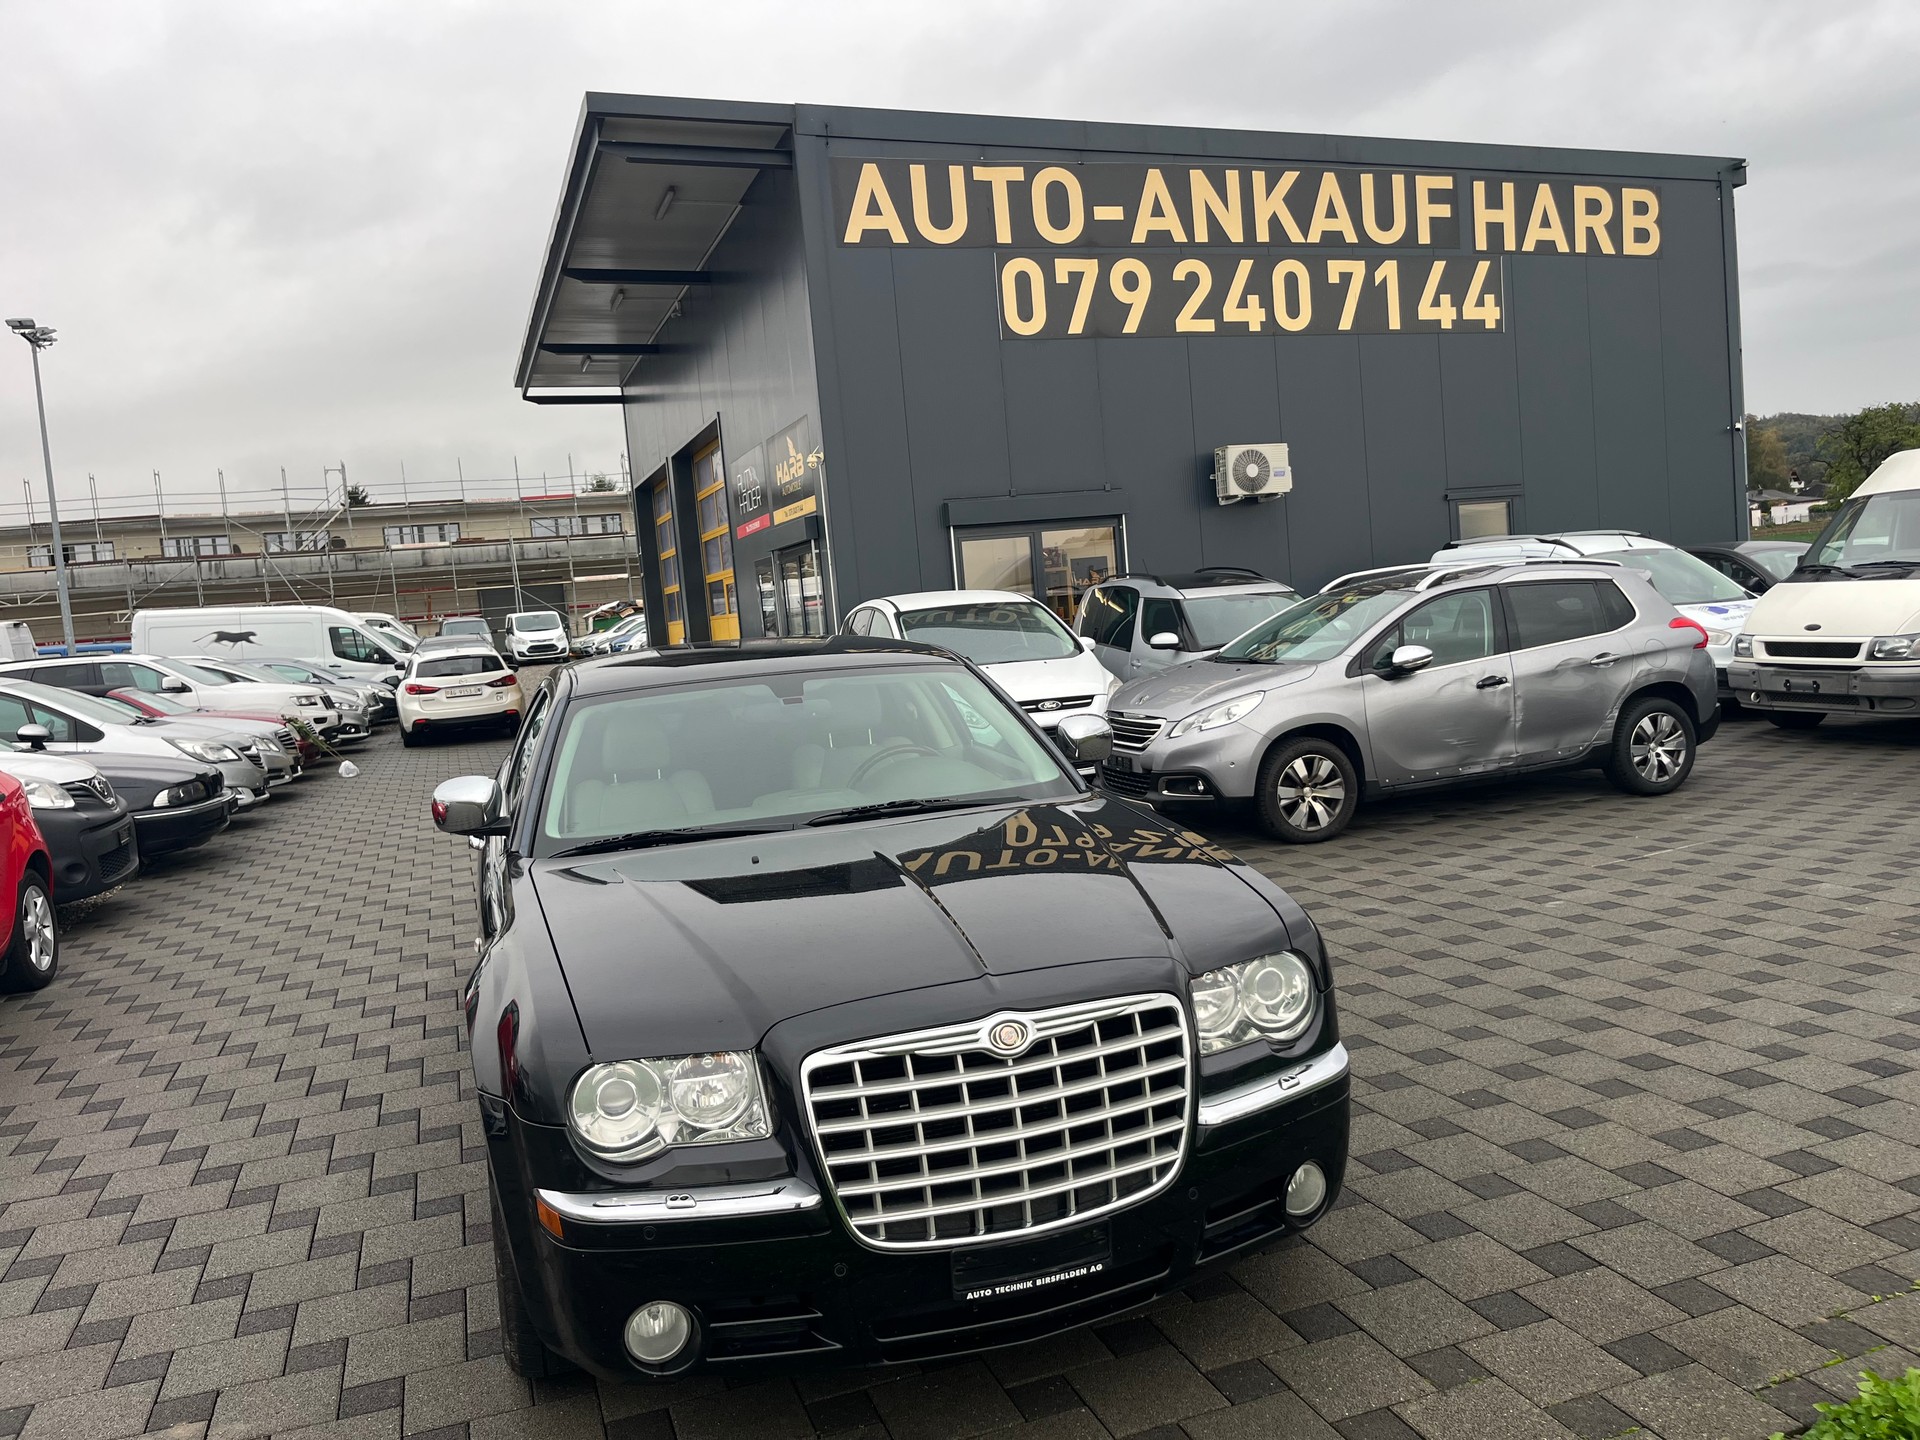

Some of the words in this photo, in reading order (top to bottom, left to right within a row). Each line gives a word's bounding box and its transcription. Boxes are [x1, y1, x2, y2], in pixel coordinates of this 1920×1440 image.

[845, 163, 1453, 245] AUTO-ANKAUF
[1473, 180, 1660, 256] HARB
[1001, 257, 1152, 336] 079
[1172, 258, 1312, 333] 240
[1327, 259, 1401, 331] 71
[1417, 260, 1501, 329] 44
[775, 453, 804, 486] HARB
[966, 1288, 993, 1300] AUTO
[995, 1280, 1034, 1295] TECHNIK
[1036, 1268, 1088, 1286] BIRSFELDEN
[1089, 1263, 1104, 1274] AG
